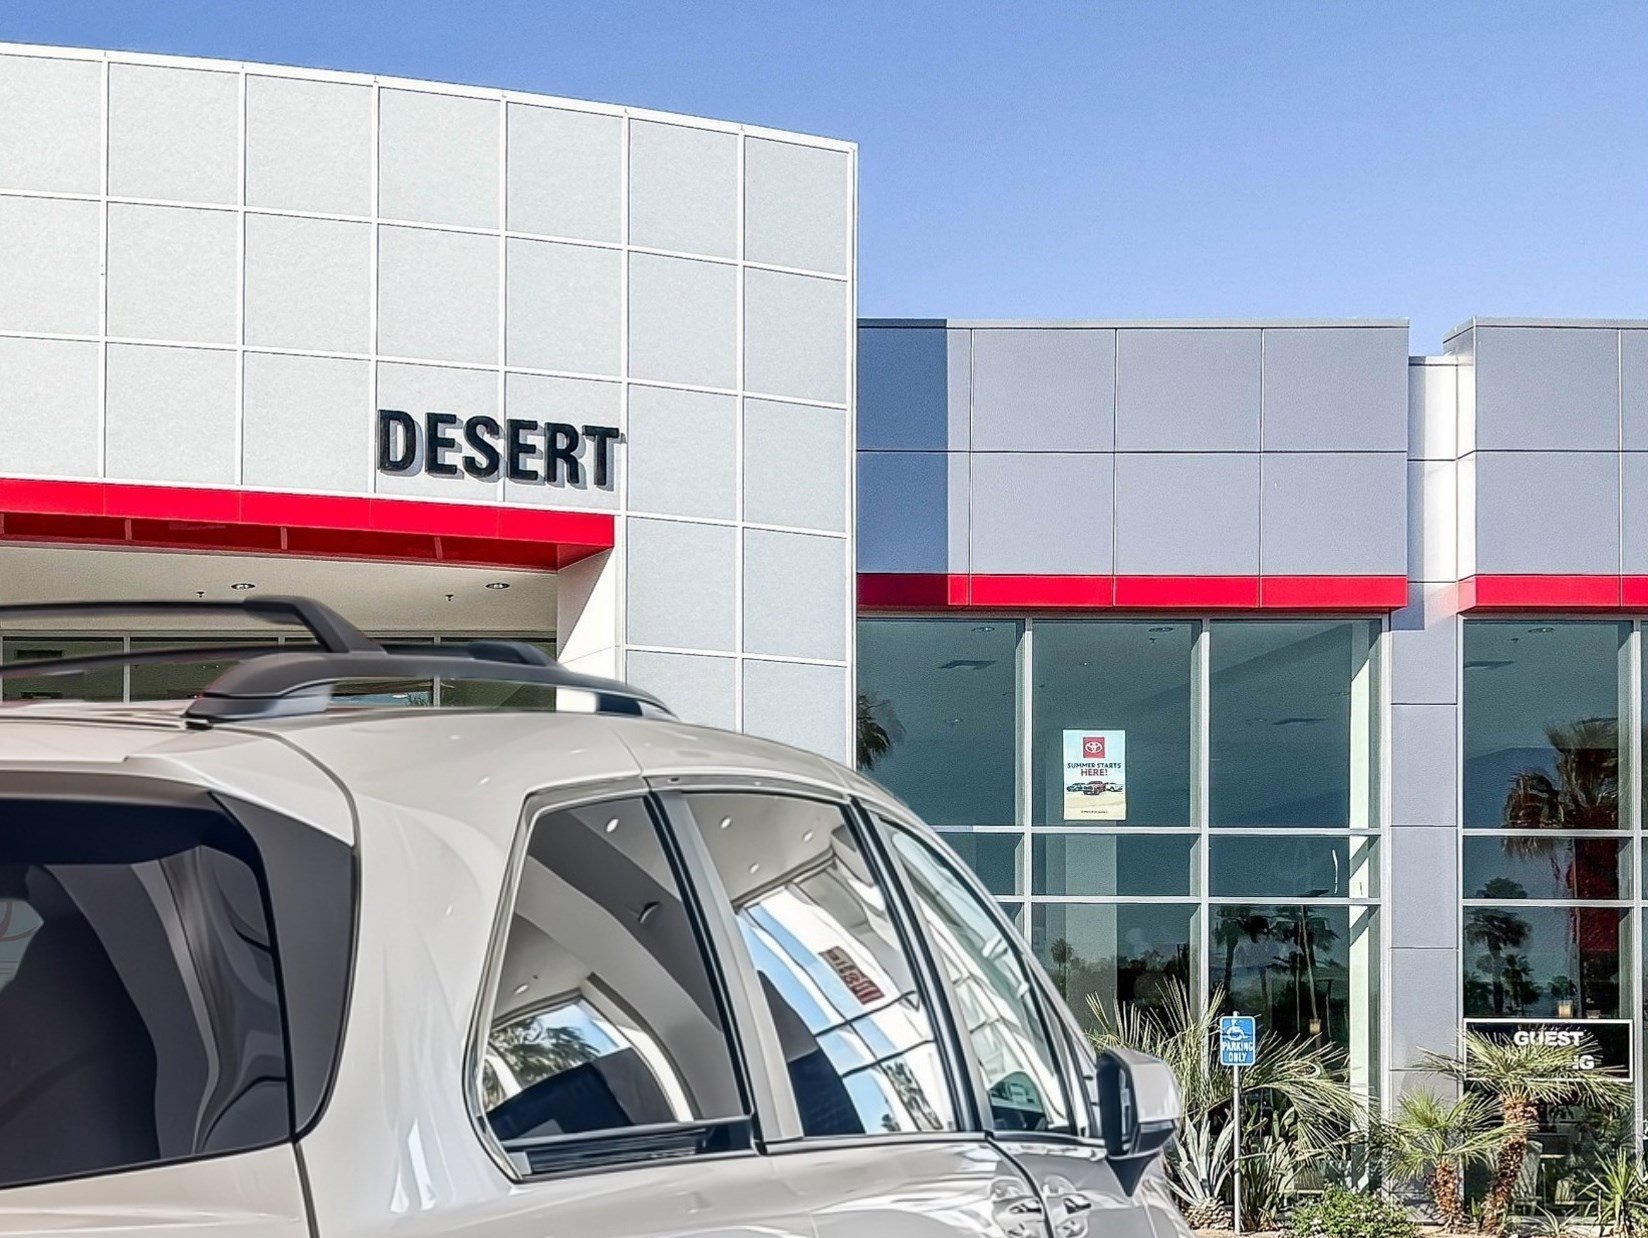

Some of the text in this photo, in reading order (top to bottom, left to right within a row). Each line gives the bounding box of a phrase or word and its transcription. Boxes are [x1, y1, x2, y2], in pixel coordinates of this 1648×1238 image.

[377, 409, 620, 487] DESERT
[1513, 1030, 1584, 1047] GUEST
[1222, 1041, 1253, 1051] PARKING
[1228, 1052, 1247, 1062] ONLY
